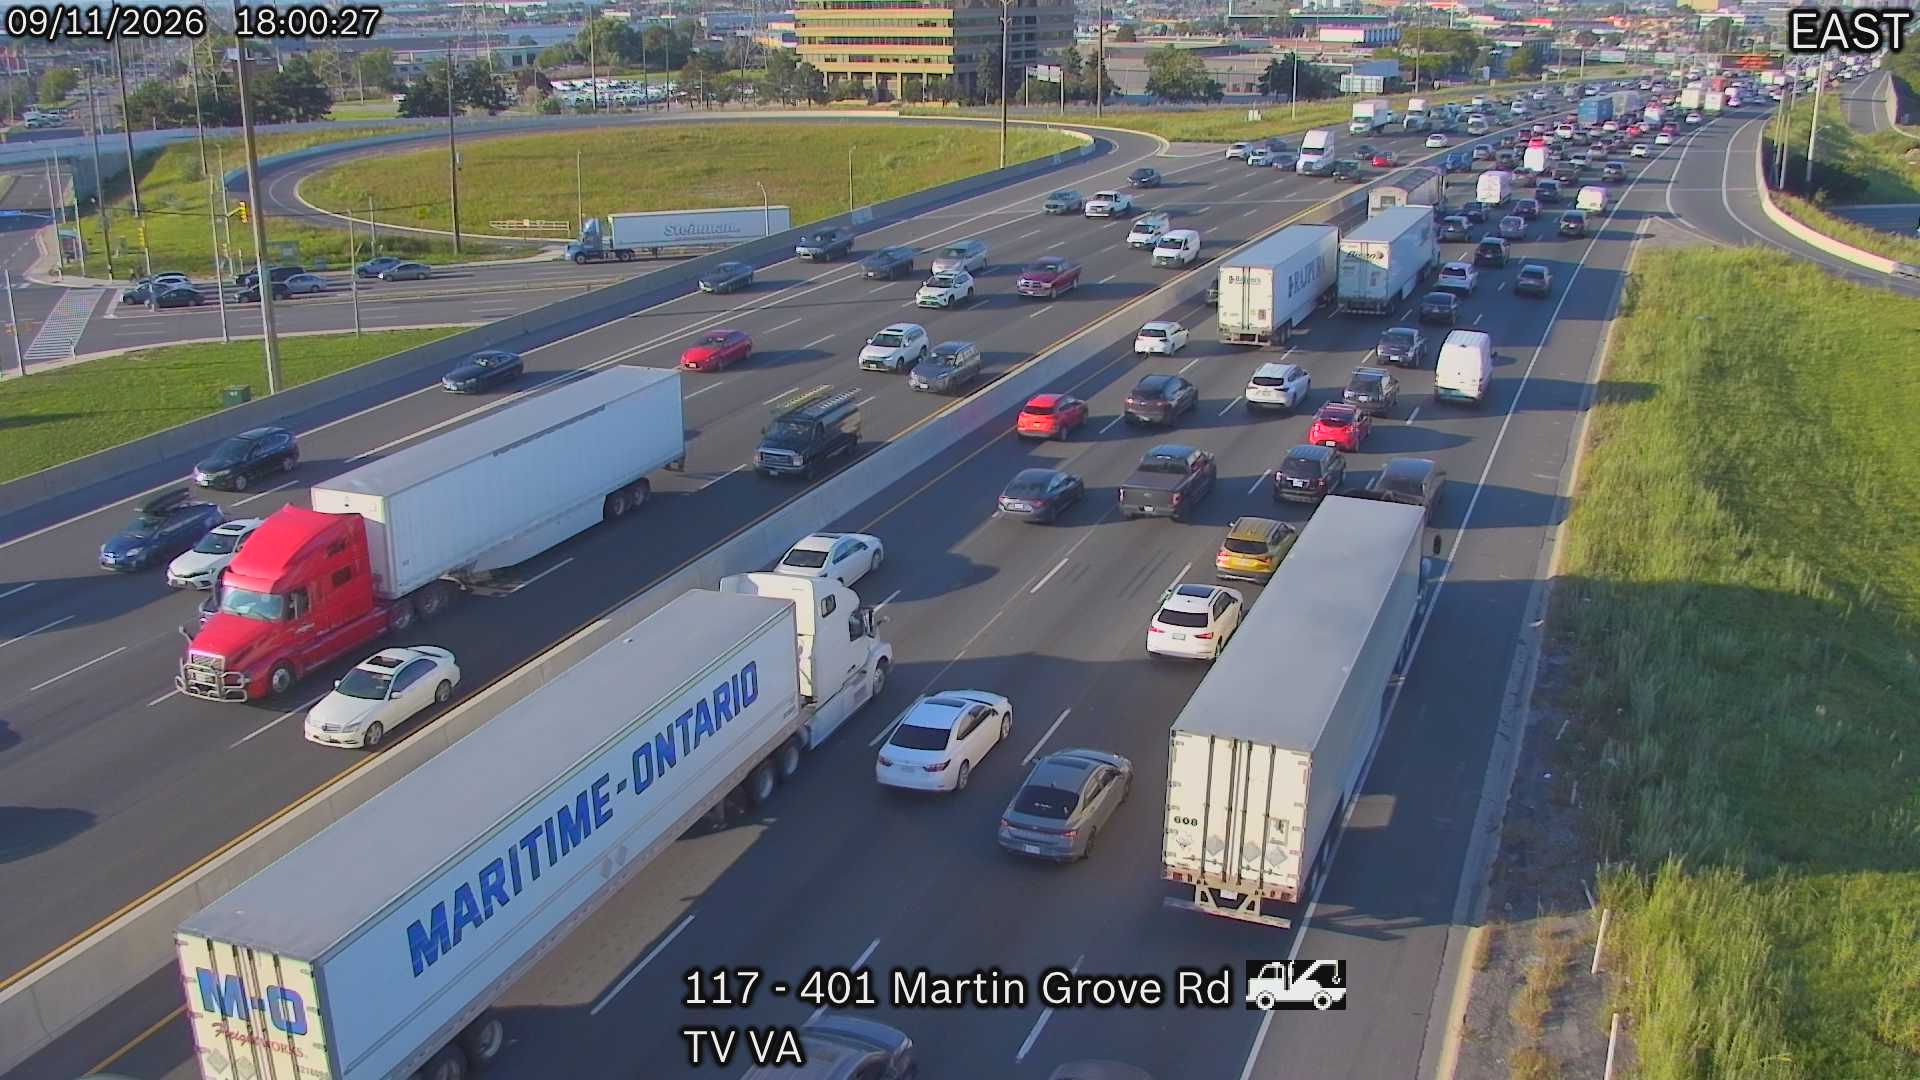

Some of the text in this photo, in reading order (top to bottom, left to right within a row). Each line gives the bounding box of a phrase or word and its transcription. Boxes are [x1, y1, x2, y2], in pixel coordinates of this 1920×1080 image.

[406, 660, 760, 978] MARITIME-ONTARIO
[1173, 815, 1199, 827] 608
[196, 966, 308, 1036] M-O
